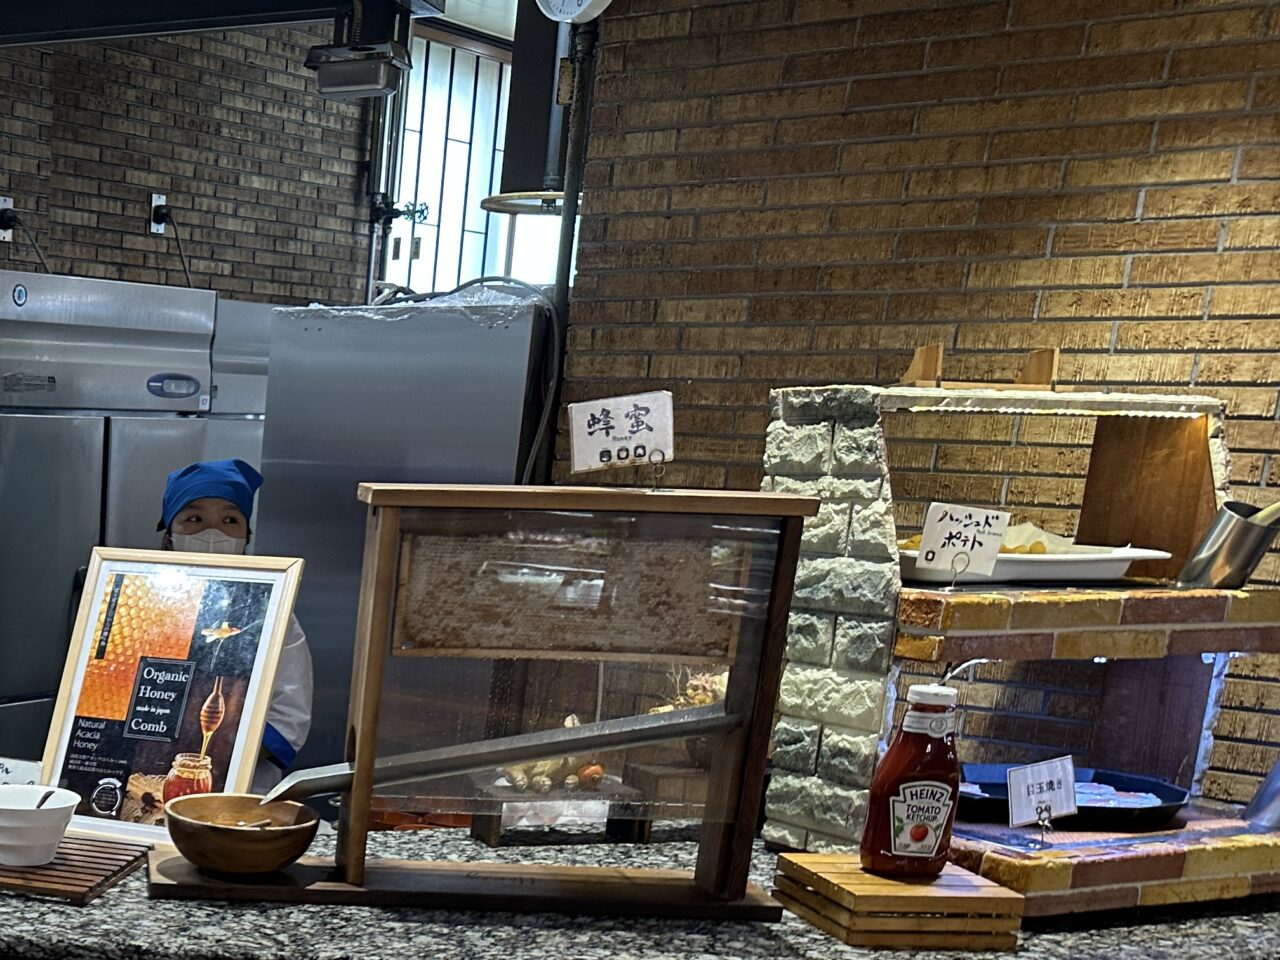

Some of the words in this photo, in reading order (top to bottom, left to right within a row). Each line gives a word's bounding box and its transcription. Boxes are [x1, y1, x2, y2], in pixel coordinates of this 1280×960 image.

[587, 403, 654, 438] 蜂蜜
[937, 510, 1000, 529] ハッシュド
[940, 531, 984, 552] ポテト
[143, 666, 190, 684] Organic
[138, 685, 177, 702] Honey
[77, 718, 107, 730] Natural
[130, 718, 168, 733] Comb
[75, 729, 101, 741] Acacia
[73, 739, 99, 752] Honey
[909, 788, 945, 803] HEINZ
[906, 803, 941, 816] TOMATO
[905, 814, 938, 823] KETCHUP
